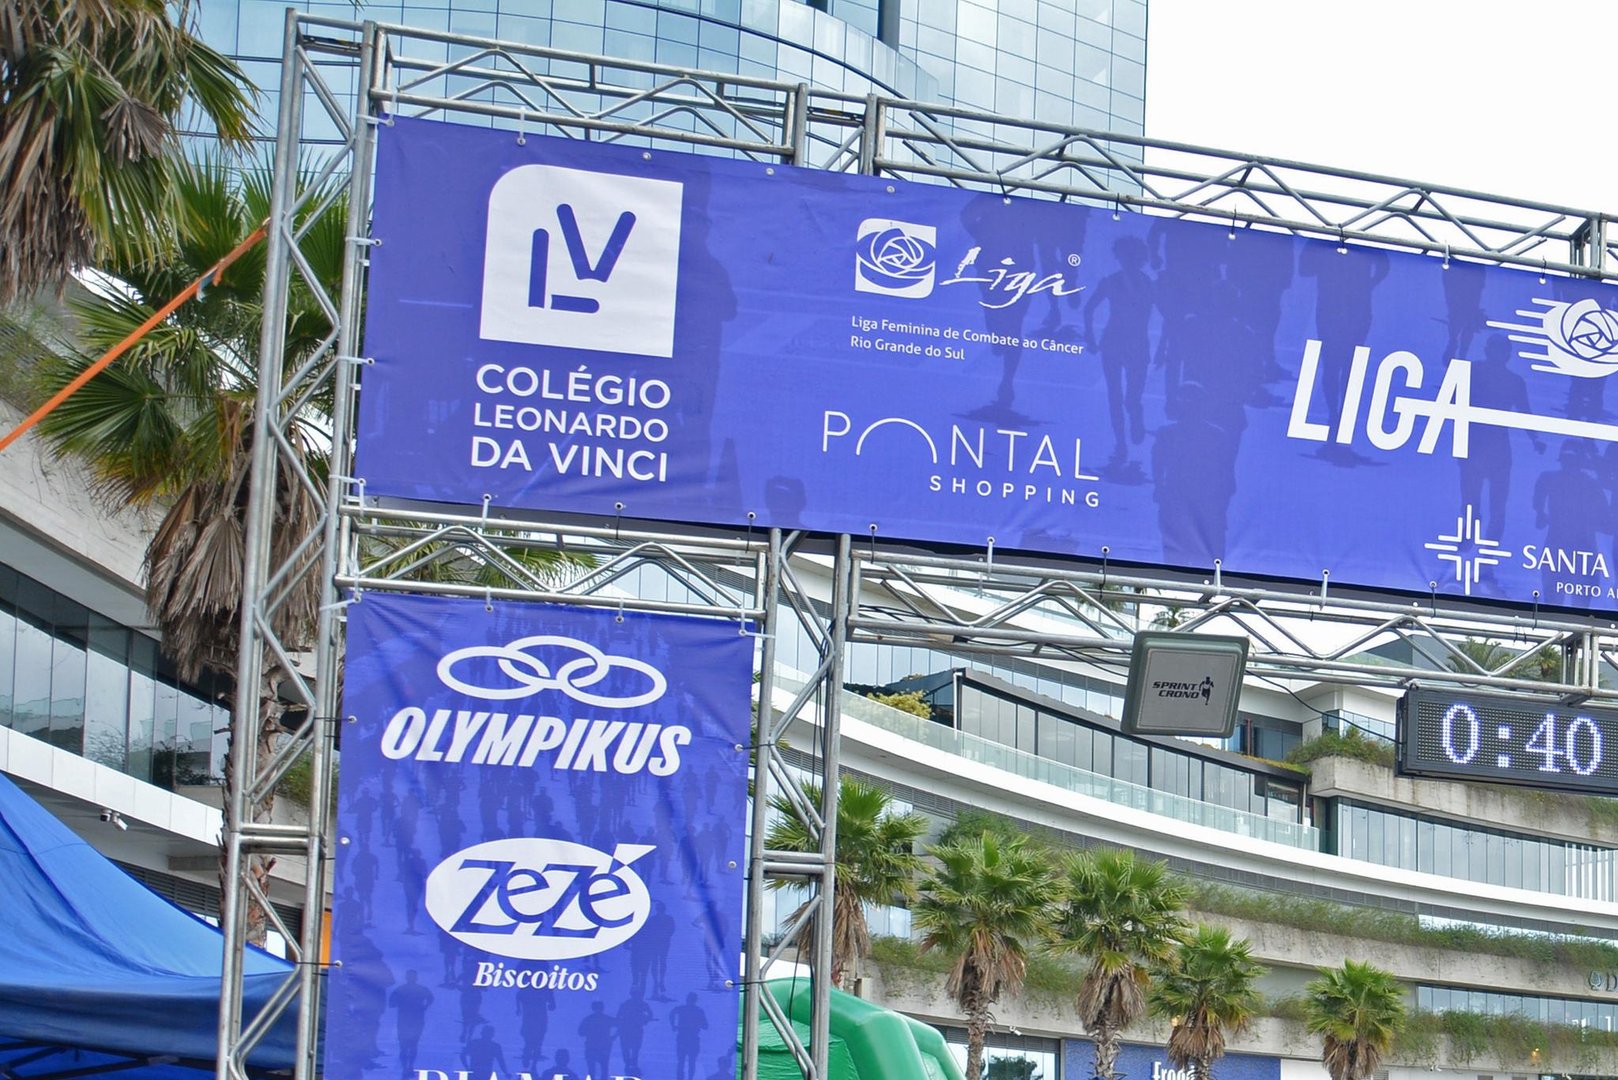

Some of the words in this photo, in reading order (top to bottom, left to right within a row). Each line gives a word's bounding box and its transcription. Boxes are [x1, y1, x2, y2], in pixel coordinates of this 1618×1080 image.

[850, 335, 872, 349] Rio
[874, 338, 922, 355] Grande
[924, 344, 942, 357] do
[944, 346, 965, 360] Sul
[851, 315, 878, 332] Liga
[881, 319, 940, 337] Feminina
[943, 327, 960, 340] de
[962, 329, 1020, 347] Combate
[1022, 338, 1038, 349] ao
[1040, 338, 1084, 354] Câncer
[475, 363, 671, 411] COLÉGIO
[1287, 339, 1473, 459] LIGA
[473, 401, 670, 443] LEONARDO
[470, 435, 532, 471] DA
[548, 442, 667, 482] VINCI
[929, 471, 1100, 508] SHOPPING
[1522, 544, 1610, 578] SANTA
[1556, 581, 1602, 598] PORTO
[1152, 681, 1198, 691] SPRINT
[1158, 689, 1199, 699] CRONO
[381, 707, 691, 777] OLYMPIKUS
[472, 961, 599, 992] Biscoitos
